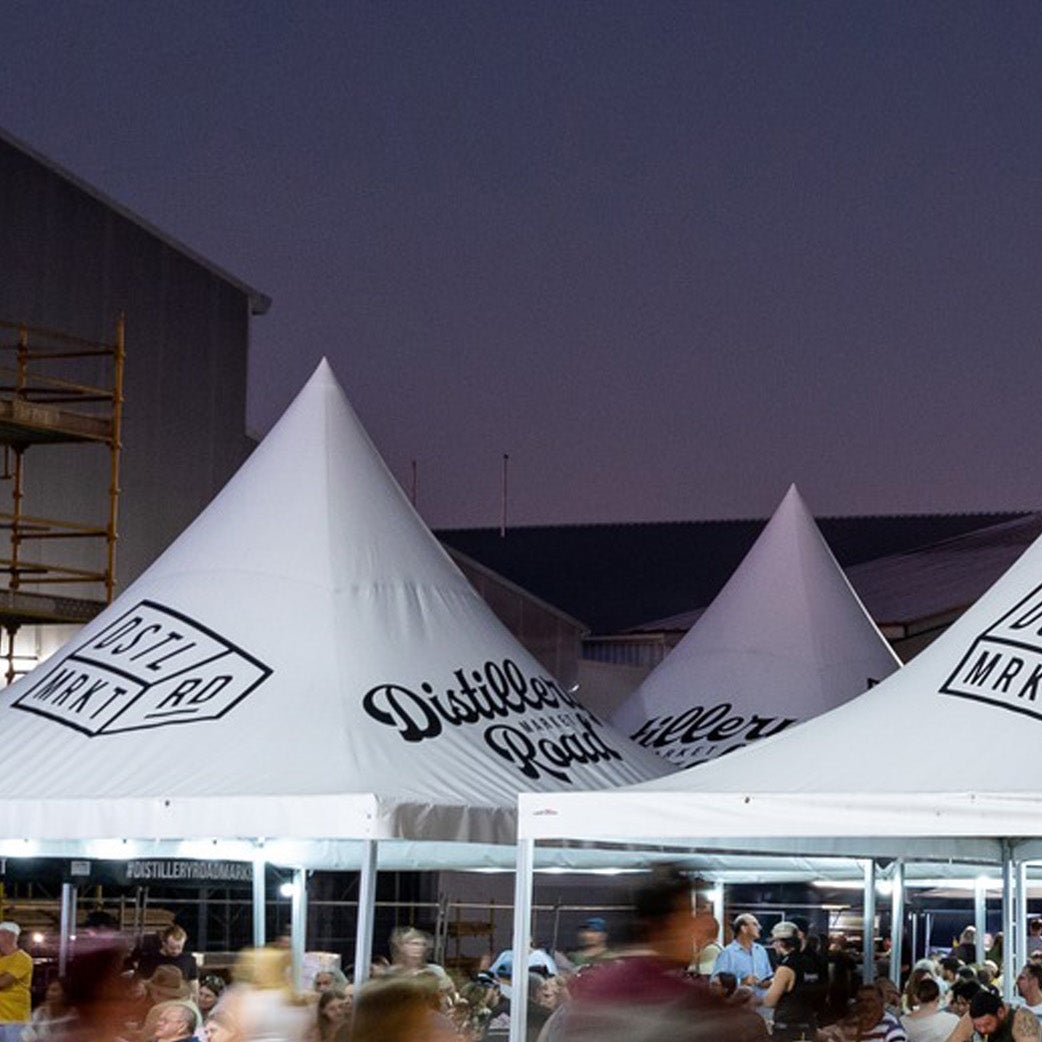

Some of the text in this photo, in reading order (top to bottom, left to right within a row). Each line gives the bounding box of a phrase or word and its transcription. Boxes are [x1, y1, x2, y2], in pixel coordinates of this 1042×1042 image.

[93, 616, 197, 671] DSTL
[33, 667, 128, 719] MRKT
[156, 675, 234, 709] RD
[484, 713, 623, 784] Road
